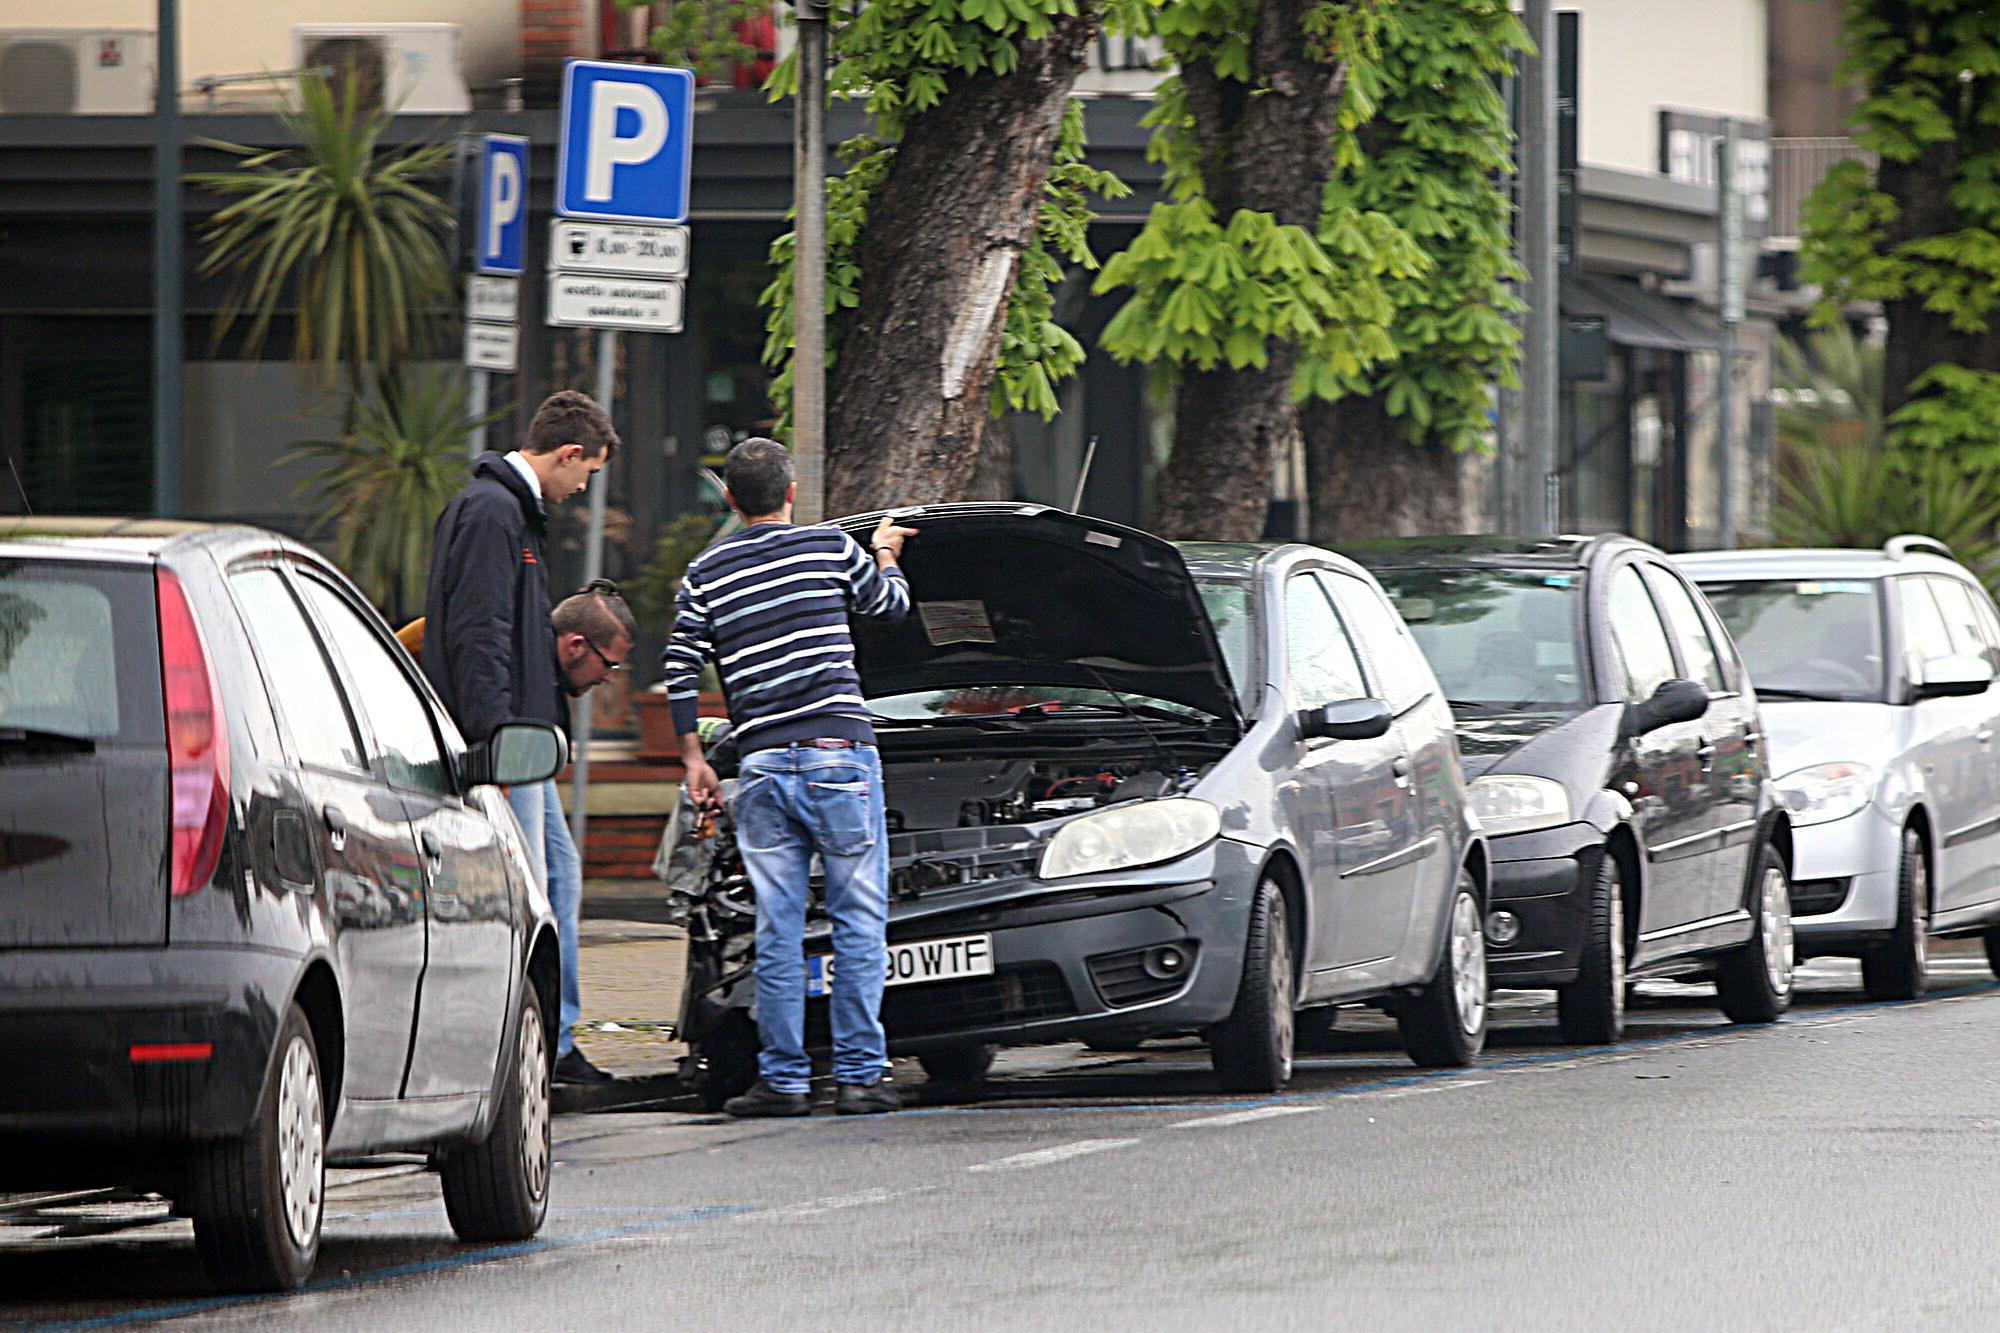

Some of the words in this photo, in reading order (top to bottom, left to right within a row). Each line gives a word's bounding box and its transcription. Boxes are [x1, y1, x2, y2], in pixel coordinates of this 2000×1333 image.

[584, 79, 669, 202] P
[488, 151, 521, 259] P
[919, 939, 987, 975] WTF
